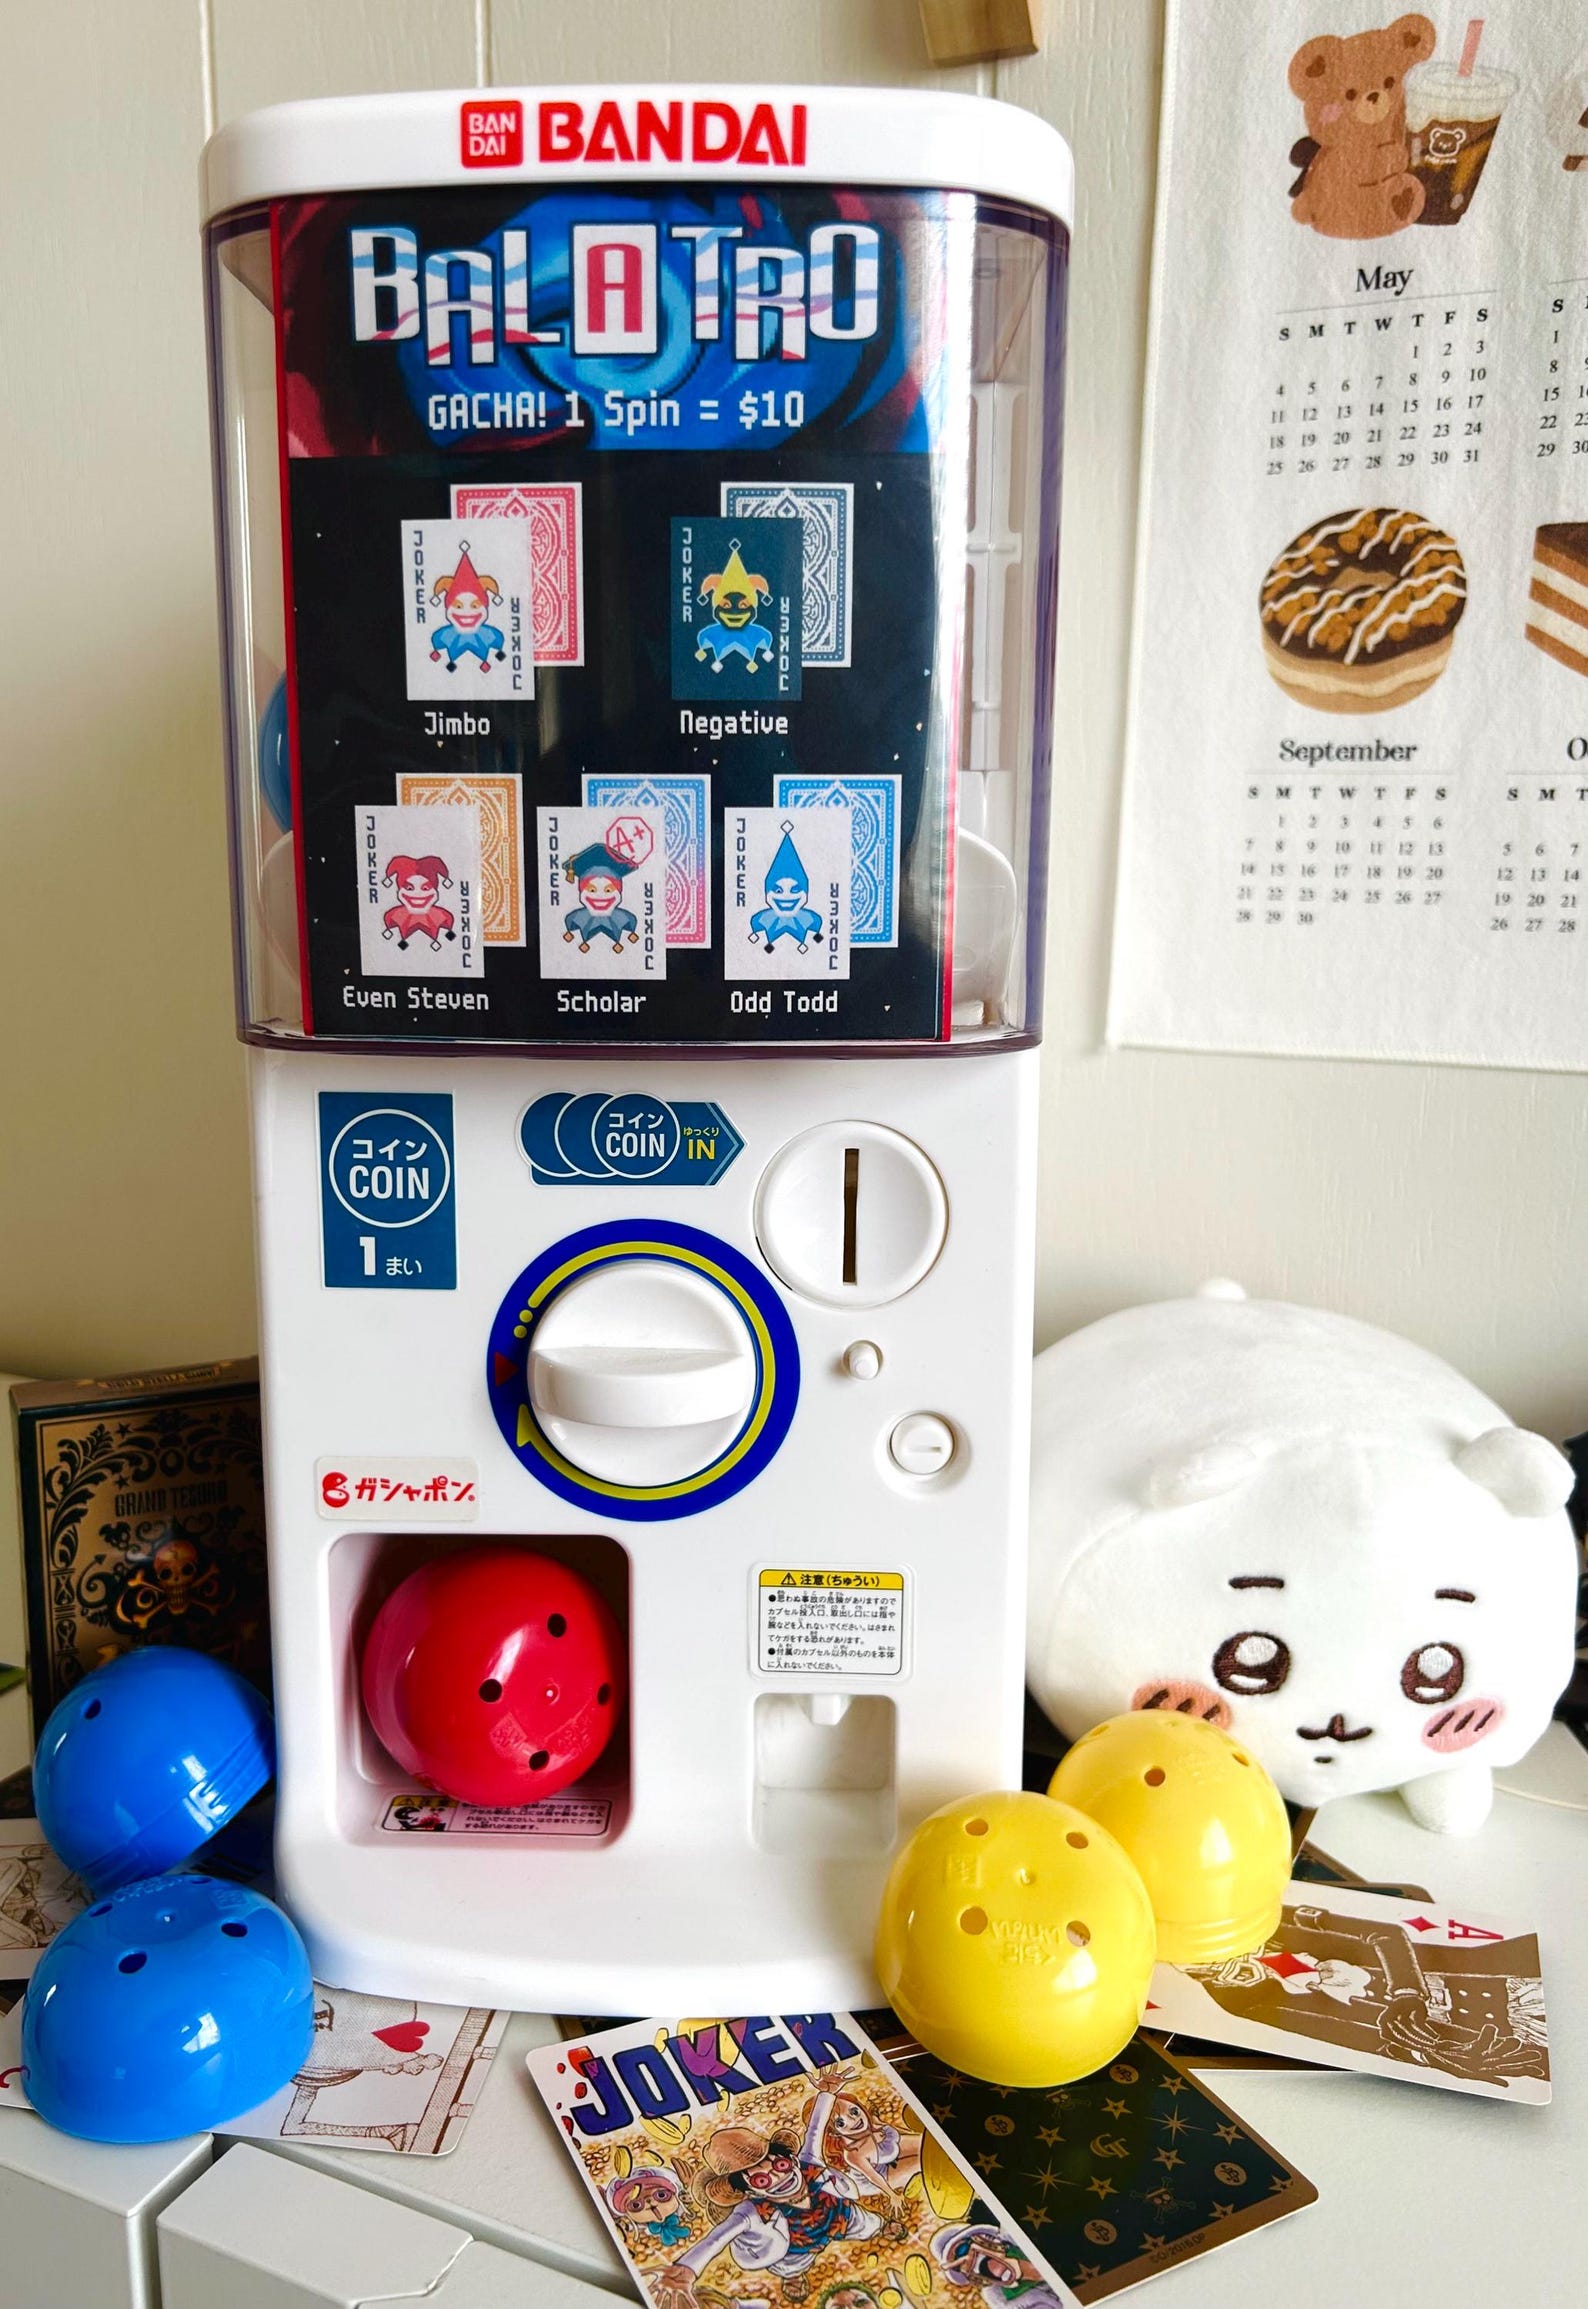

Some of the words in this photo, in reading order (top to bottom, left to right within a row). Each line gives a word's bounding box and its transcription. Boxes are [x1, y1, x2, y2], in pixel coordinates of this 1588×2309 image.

[468, 112, 516, 135] BAN
[538, 101, 807, 166] BANDAI
[468, 134, 506, 157] DAI
[1356, 266, 1414, 296] May
[352, 223, 880, 366] BALATRO
[1552, 299, 1563, 313] S
[1280, 328, 1289, 340] S
[1310, 324, 1324, 337] M
[1344, 321, 1356, 334] T
[1375, 317, 1392, 331] W
[1412, 314, 1424, 327] T
[1445, 311, 1456, 324] F
[1477, 309, 1488, 322] S
[1554, 330, 1558, 343] 1
[1414, 346, 1418, 358] 1
[1443, 343, 1452, 356] 2
[1476, 340, 1484, 353] 3
[1550, 360, 1558, 373] 8
[1277, 385, 1284, 396] 4
[1308, 382, 1316, 394] 5
[1342, 380, 1350, 392] 6
[1376, 376, 1383, 388] 7
[1409, 373, 1417, 385] 8
[1442, 370, 1450, 383] 9
[1471, 368, 1487, 381] 10
[1544, 387, 1559, 401] 15
[1579, 385, 1588, 398] 1
[428, 391, 547, 431] GACHA!
[564, 390, 585, 428] 1
[604, 389, 680, 437] Spin
[699, 399, 719, 421] =
[739, 390, 805, 430] $10
[1272, 410, 1284, 423] 11
[1303, 408, 1317, 421] 12
[1338, 405, 1351, 419] 13
[1370, 403, 1384, 416] 14
[1404, 400, 1418, 413] 15
[1437, 397, 1452, 410] 16
[1469, 395, 1484, 408] 17
[1540, 415, 1557, 429] 22
[1271, 436, 1284, 448] 18
[1302, 434, 1316, 447] 19
[1334, 432, 1350, 445] 20
[1368, 429, 1381, 442] 21
[1400, 426, 1416, 440] 22
[1433, 424, 1450, 437] 23
[1465, 422, 1482, 435] 24
[1268, 462, 1283, 475] 25
[1299, 460, 1314, 473] 26
[1333, 457, 1349, 471] 27
[1367, 456, 1381, 469] 28
[1398, 453, 1414, 466] 29
[1432, 451, 1448, 464] 30
[1464, 449, 1478, 462] 31
[1537, 443, 1556, 457] 29
[413, 530, 426, 624] JOKER
[682, 527, 693, 623] JOKER
[510, 597, 523, 691] JOKER
[778, 596, 790, 692] JOKER
[424, 711, 491, 736] Jimbo
[680, 709, 789, 741] Negative
[1507, 787, 1519, 801] S
[1538, 787, 1557, 801] M
[1576, 787, 1588, 801] T
[612, 824, 647, 856] A+
[1503, 842, 1512, 856] 5
[1535, 843, 1545, 856] 6
[1570, 843, 1579, 856] 7
[366, 815, 379, 904] JOKER
[547, 815, 561, 908] JOKER
[736, 817, 746, 908] JOKER
[1497, 867, 1513, 881] 12
[1531, 868, 1547, 882] 13
[1564, 869, 1580, 882] 14
[1495, 893, 1512, 906] 19
[1527, 893, 1546, 907] 20
[1560, 894, 1577, 908] 21
[459, 880, 472, 969] JOKER
[644, 882, 655, 971] JOKER
[828, 882, 840, 971] JOKER
[1490, 917, 1508, 931] 26
[1525, 918, 1544, 932] 27
[1558, 919, 1576, 933] 28
[342, 985, 397, 1009] Even
[407, 986, 489, 1011] Steven
[557, 989, 647, 1013] Scholar
[730, 990, 772, 1013] Odd
[783, 990, 838, 1013] Todd
[608, 1112, 664, 1130] コイン
[683, 1126, 720, 1137] ゆっくり
[352, 1138, 428, 1162] コイン
[605, 1131, 665, 1158] COIN
[688, 1138, 715, 1160] IN
[349, 1164, 430, 1200] COIN
[359, 1236, 376, 1276] 1
[385, 1256, 423, 1276] まい
[1447, 1919, 1504, 1941] A
[570, 2014, 861, 2136] JOKER
